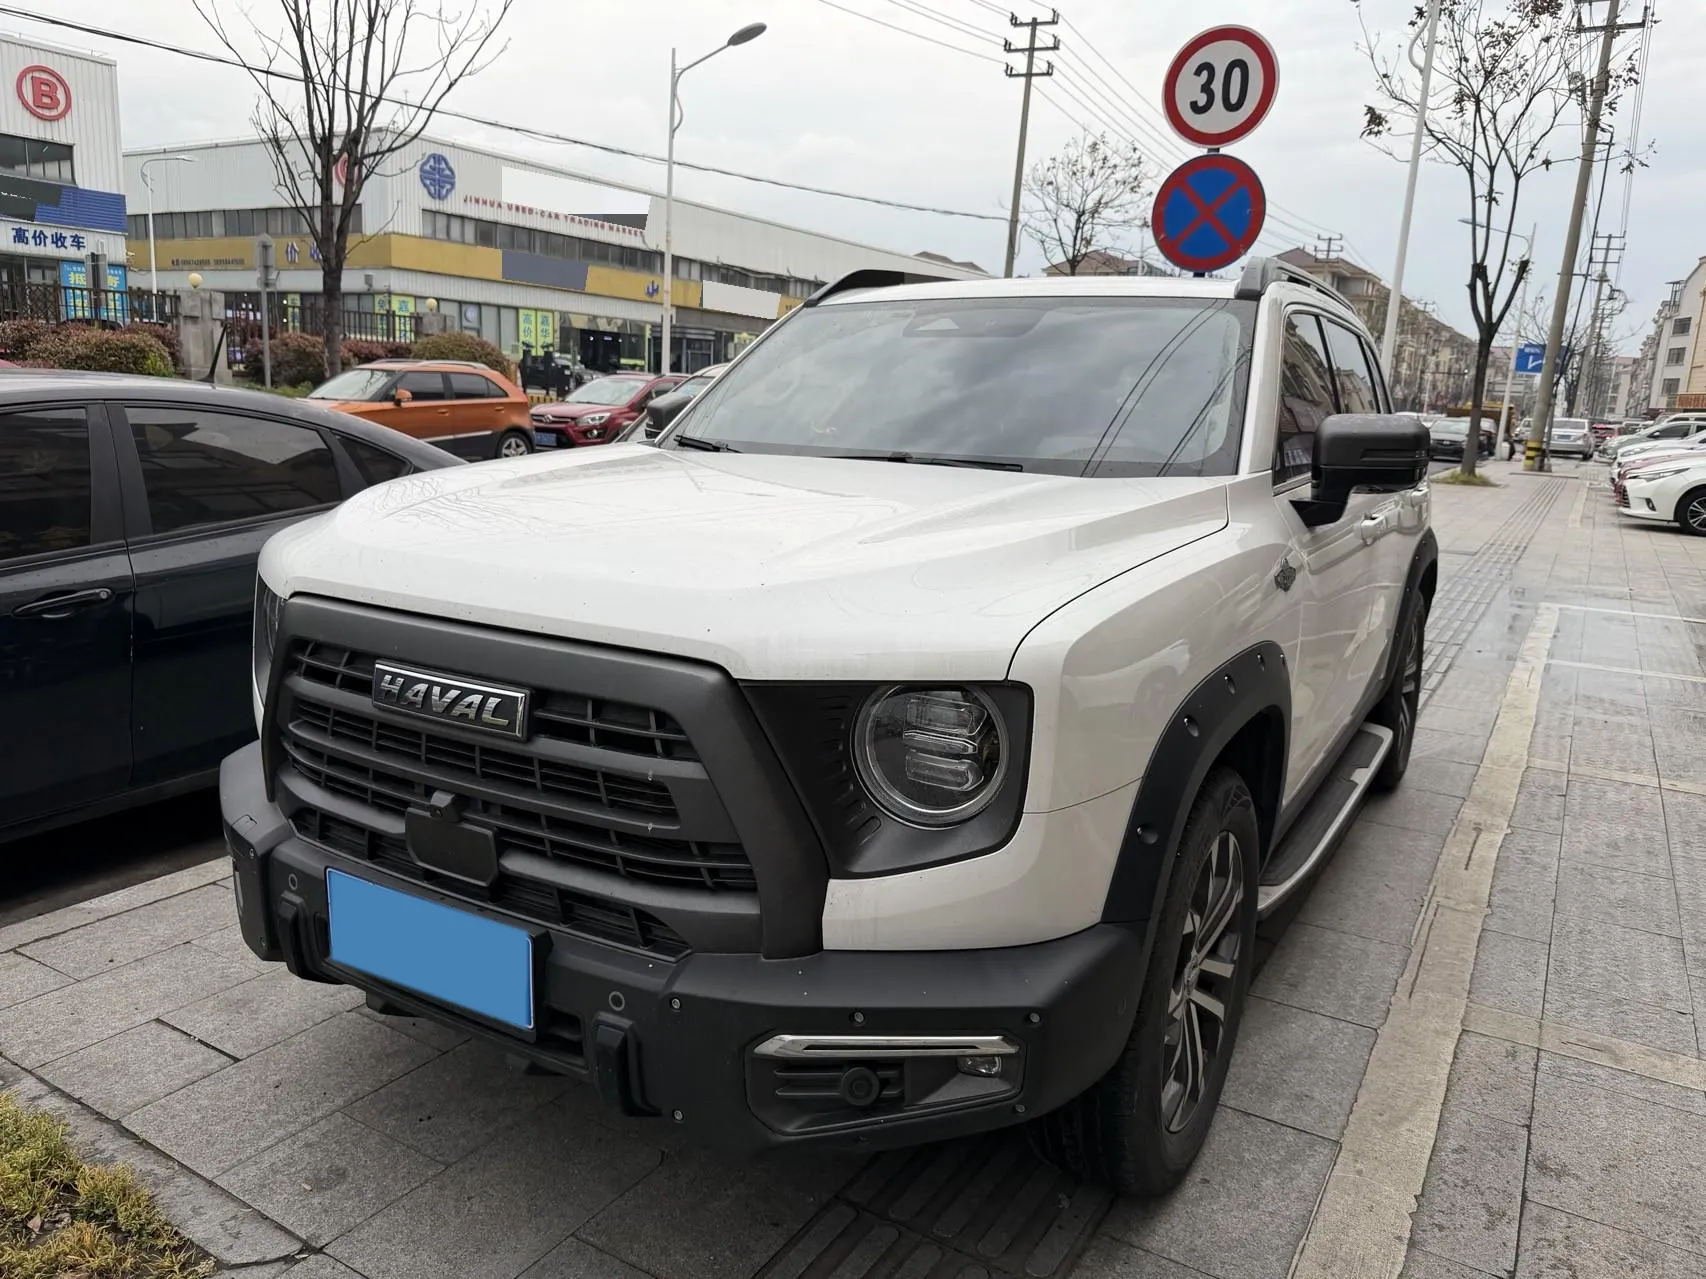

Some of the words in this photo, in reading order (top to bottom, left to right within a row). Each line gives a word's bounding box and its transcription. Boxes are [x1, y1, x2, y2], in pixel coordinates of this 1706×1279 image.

[31, 76, 61, 109] B
[1190, 58, 1249, 115] 30
[463, 194, 503, 209] JINHUA
[564, 214, 605, 230] TRADING
[608, 223, 644, 237] MARKET
[12, 227, 86, 251] 高价收车
[380, 674, 509, 727] HAVAL
